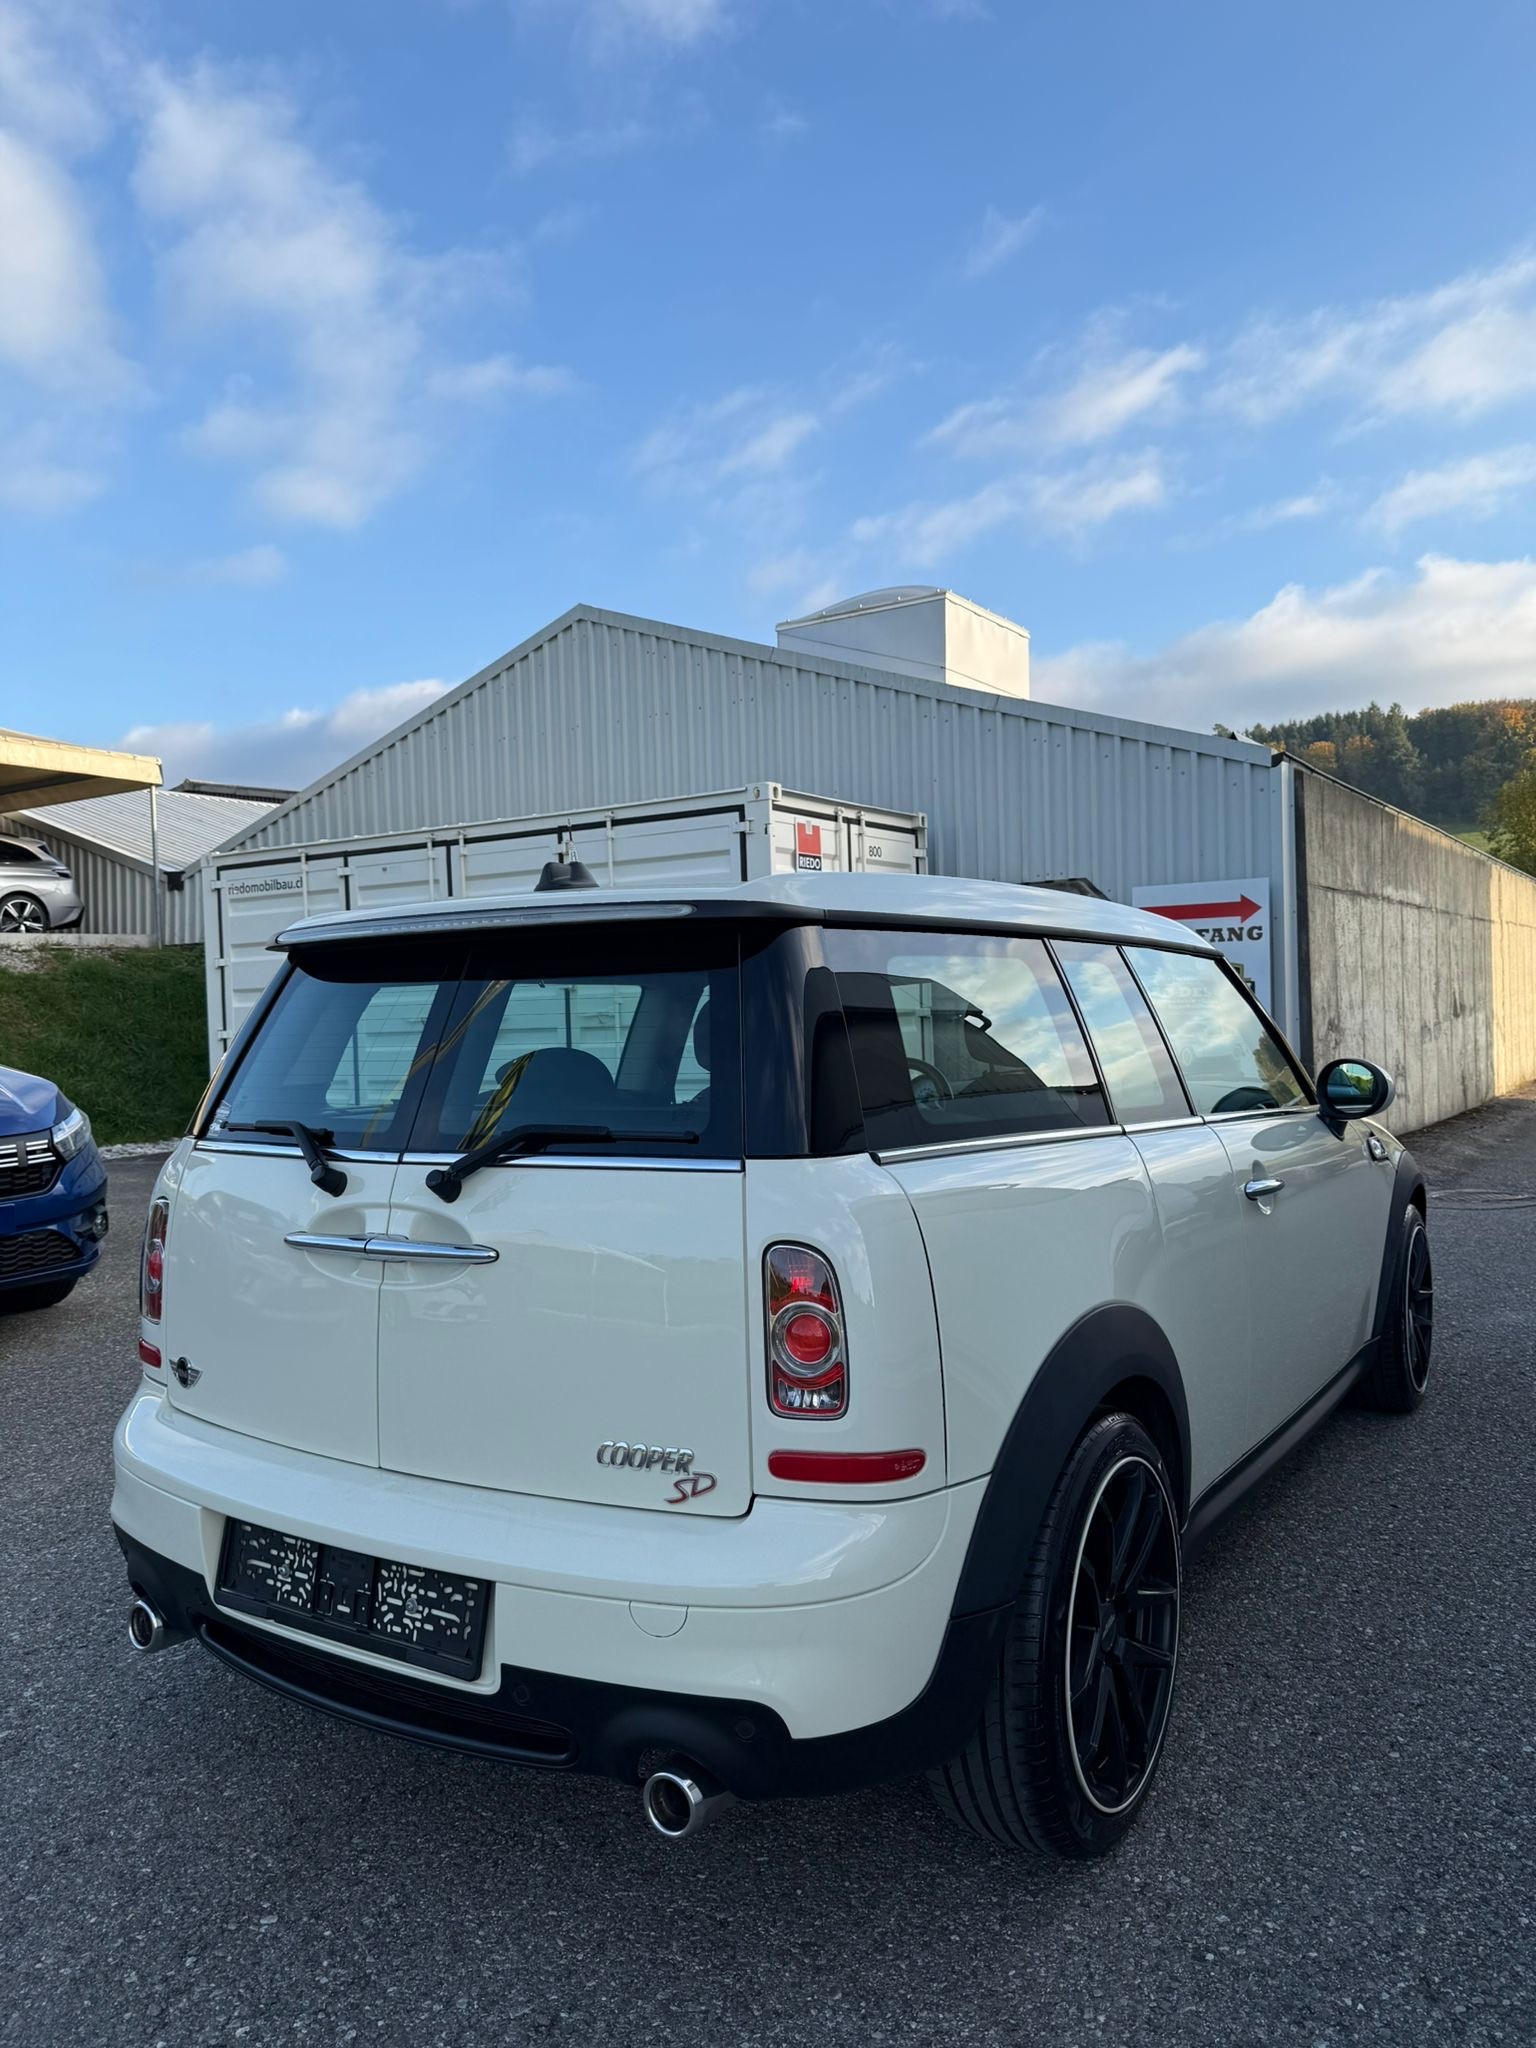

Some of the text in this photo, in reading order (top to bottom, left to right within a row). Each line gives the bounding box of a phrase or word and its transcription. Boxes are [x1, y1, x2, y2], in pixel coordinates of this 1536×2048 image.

[799, 856, 822, 870] RIEDO
[868, 845, 882, 858] 800
[597, 1440, 695, 1475] COOPER
[664, 1471, 717, 1504] SD
